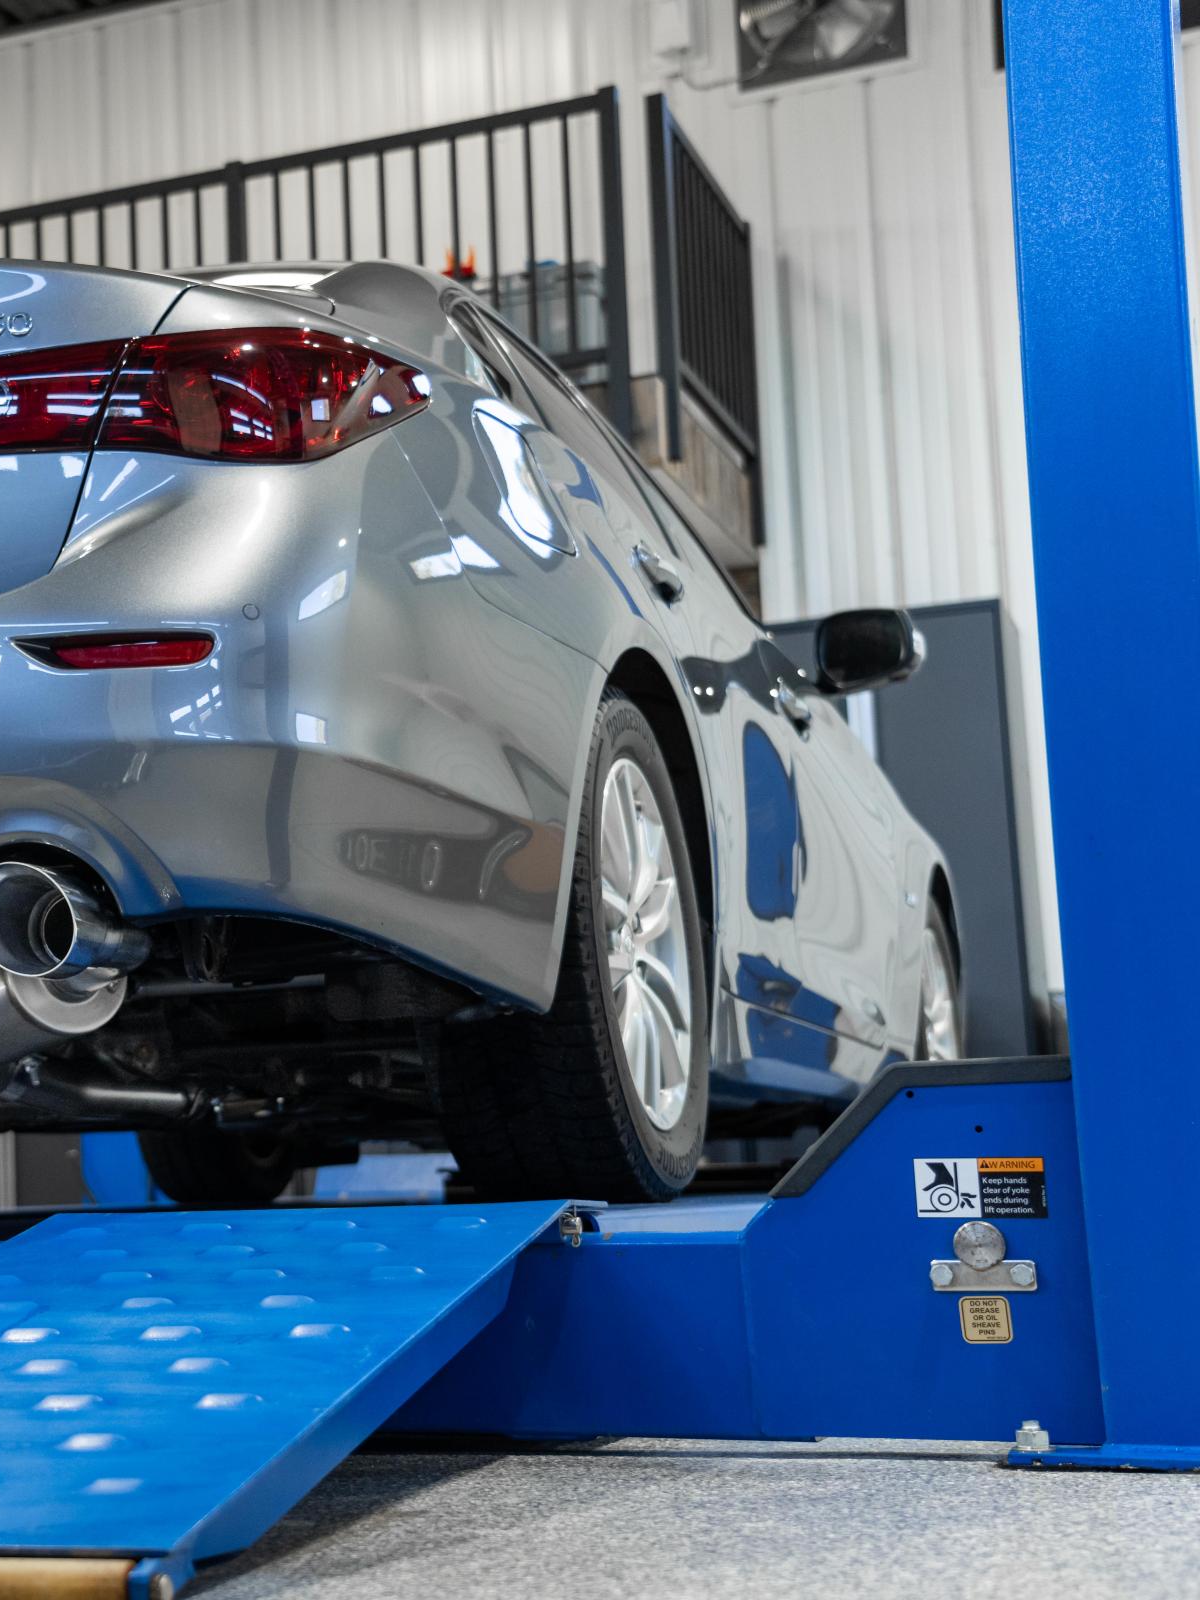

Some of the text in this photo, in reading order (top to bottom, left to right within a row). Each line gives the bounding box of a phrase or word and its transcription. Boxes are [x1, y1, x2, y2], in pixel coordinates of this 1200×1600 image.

[988, 1160, 1036, 1169] WARNING
[981, 1177, 1003, 1185] Keep
[1002, 1186, 1011, 1194] of
[1011, 1187, 1030, 1196] yoke
[983, 1196, 1029, 1205] ends during
[995, 1206, 1035, 1214] operation.
